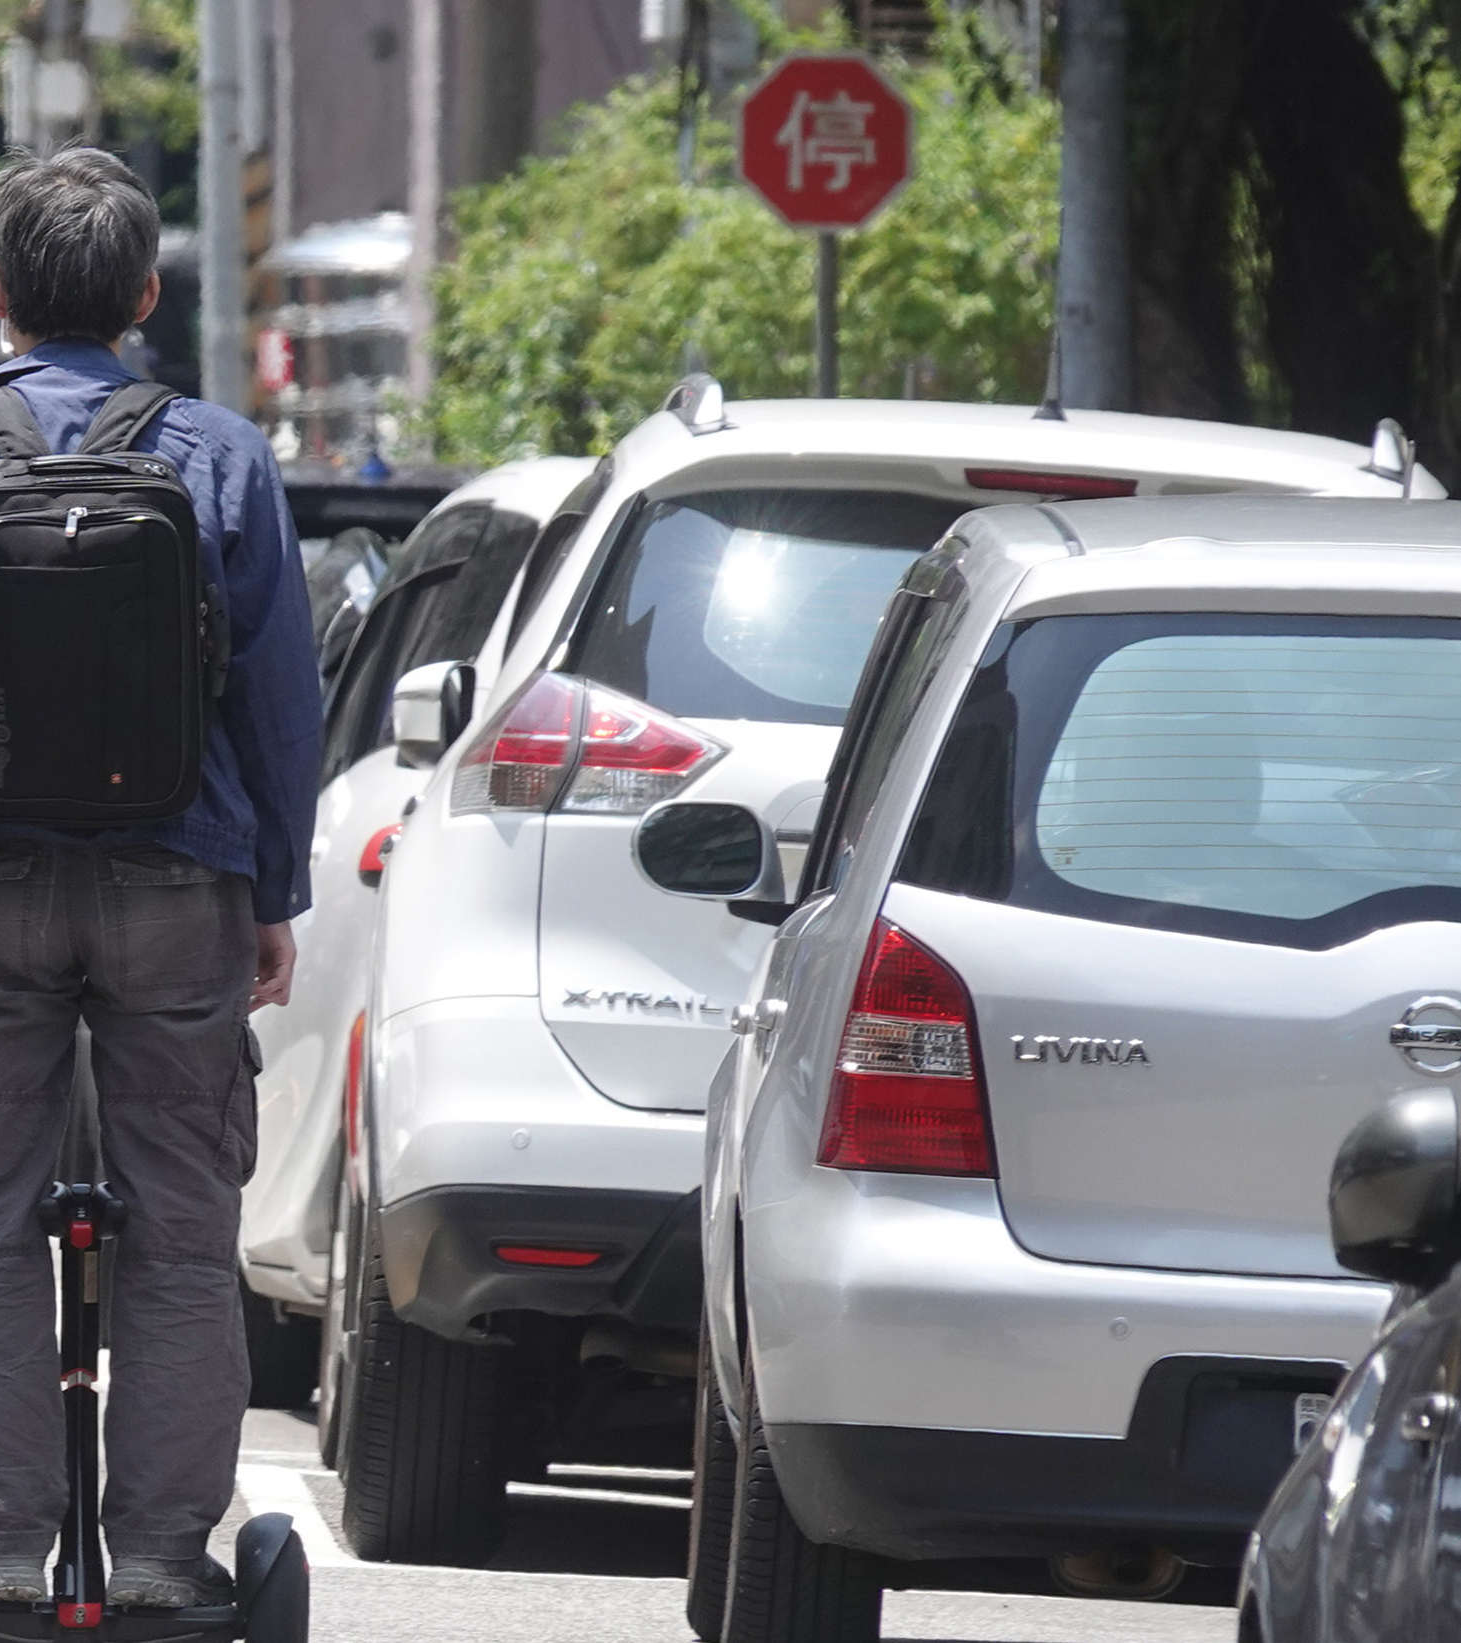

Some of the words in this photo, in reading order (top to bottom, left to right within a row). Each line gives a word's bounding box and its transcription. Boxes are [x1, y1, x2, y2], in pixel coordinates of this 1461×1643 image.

[775, 89, 877, 192] 停
[562, 988, 726, 1016] X-TRAIL
[1010, 1034, 1152, 1066] LIVINA
